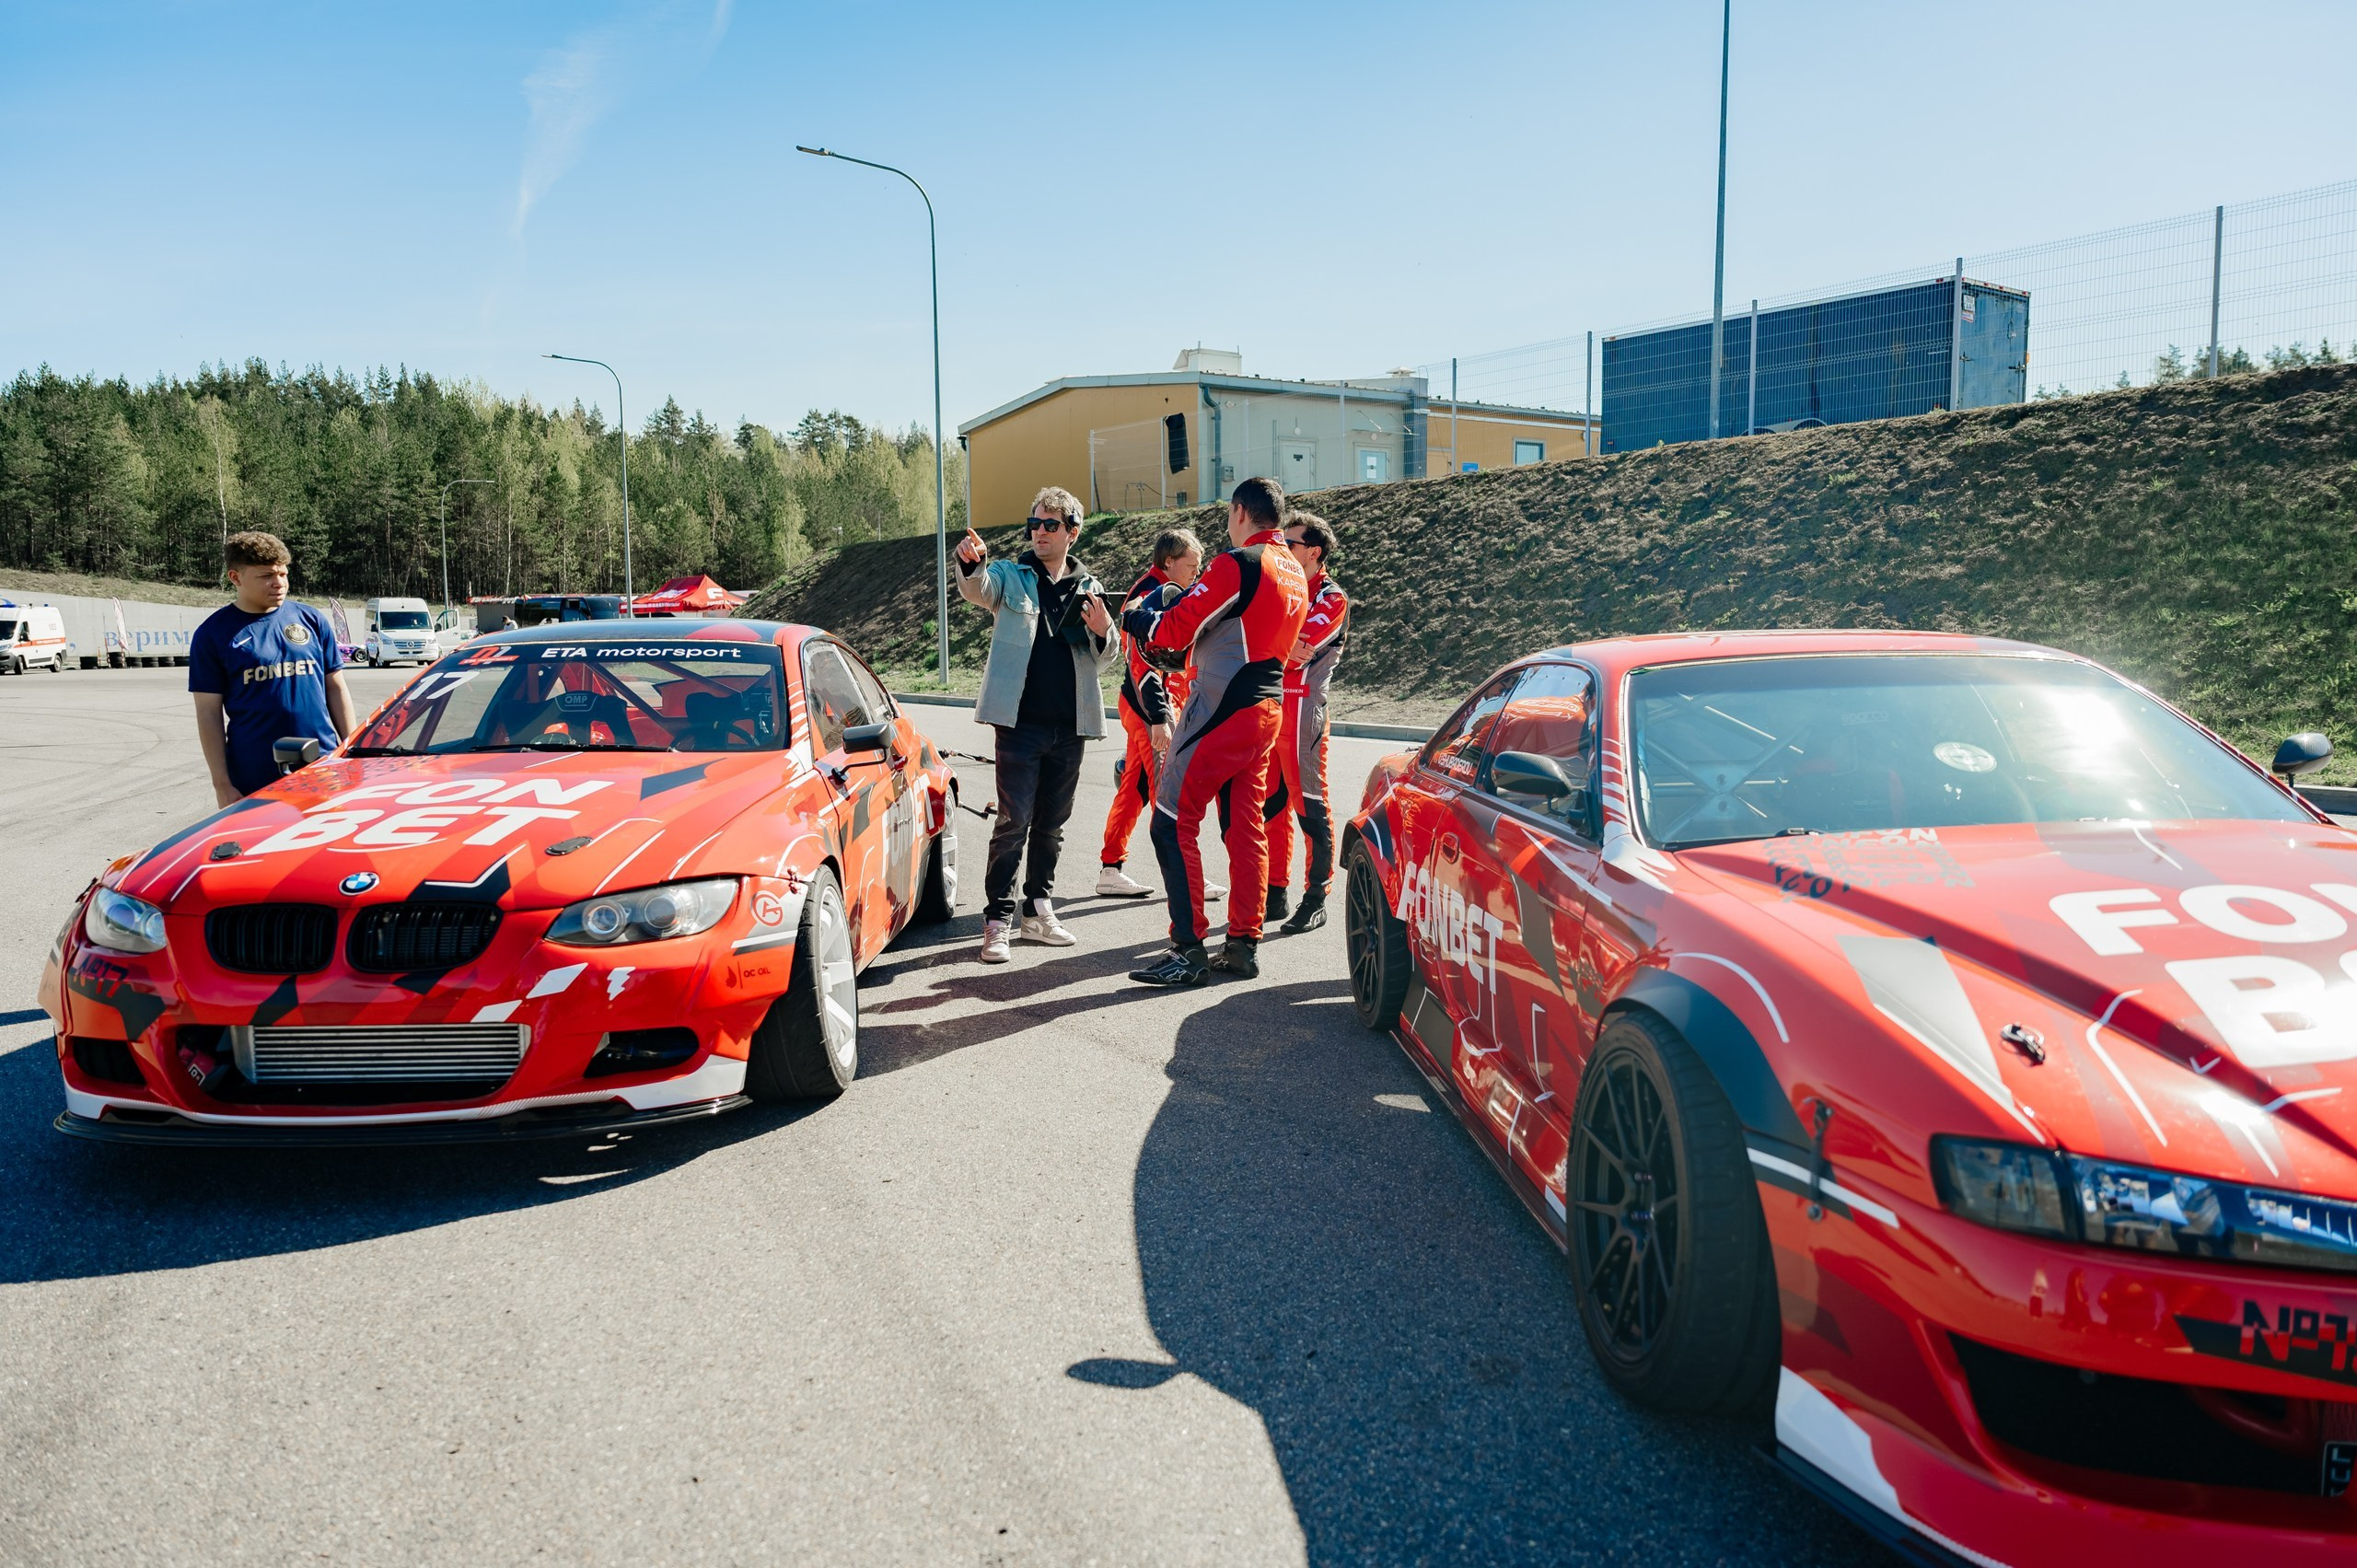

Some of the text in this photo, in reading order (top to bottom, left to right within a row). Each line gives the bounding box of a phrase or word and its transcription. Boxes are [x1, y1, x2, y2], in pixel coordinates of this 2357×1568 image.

[541, 647, 741, 658] ETA motorsport
[243, 660, 316, 685] FONBET
[407, 671, 480, 701] 17
[564, 696, 587, 704] OMP
[302, 778, 616, 814] FON
[243, 805, 582, 855] BET
[1396, 860, 1504, 994] FONBET
